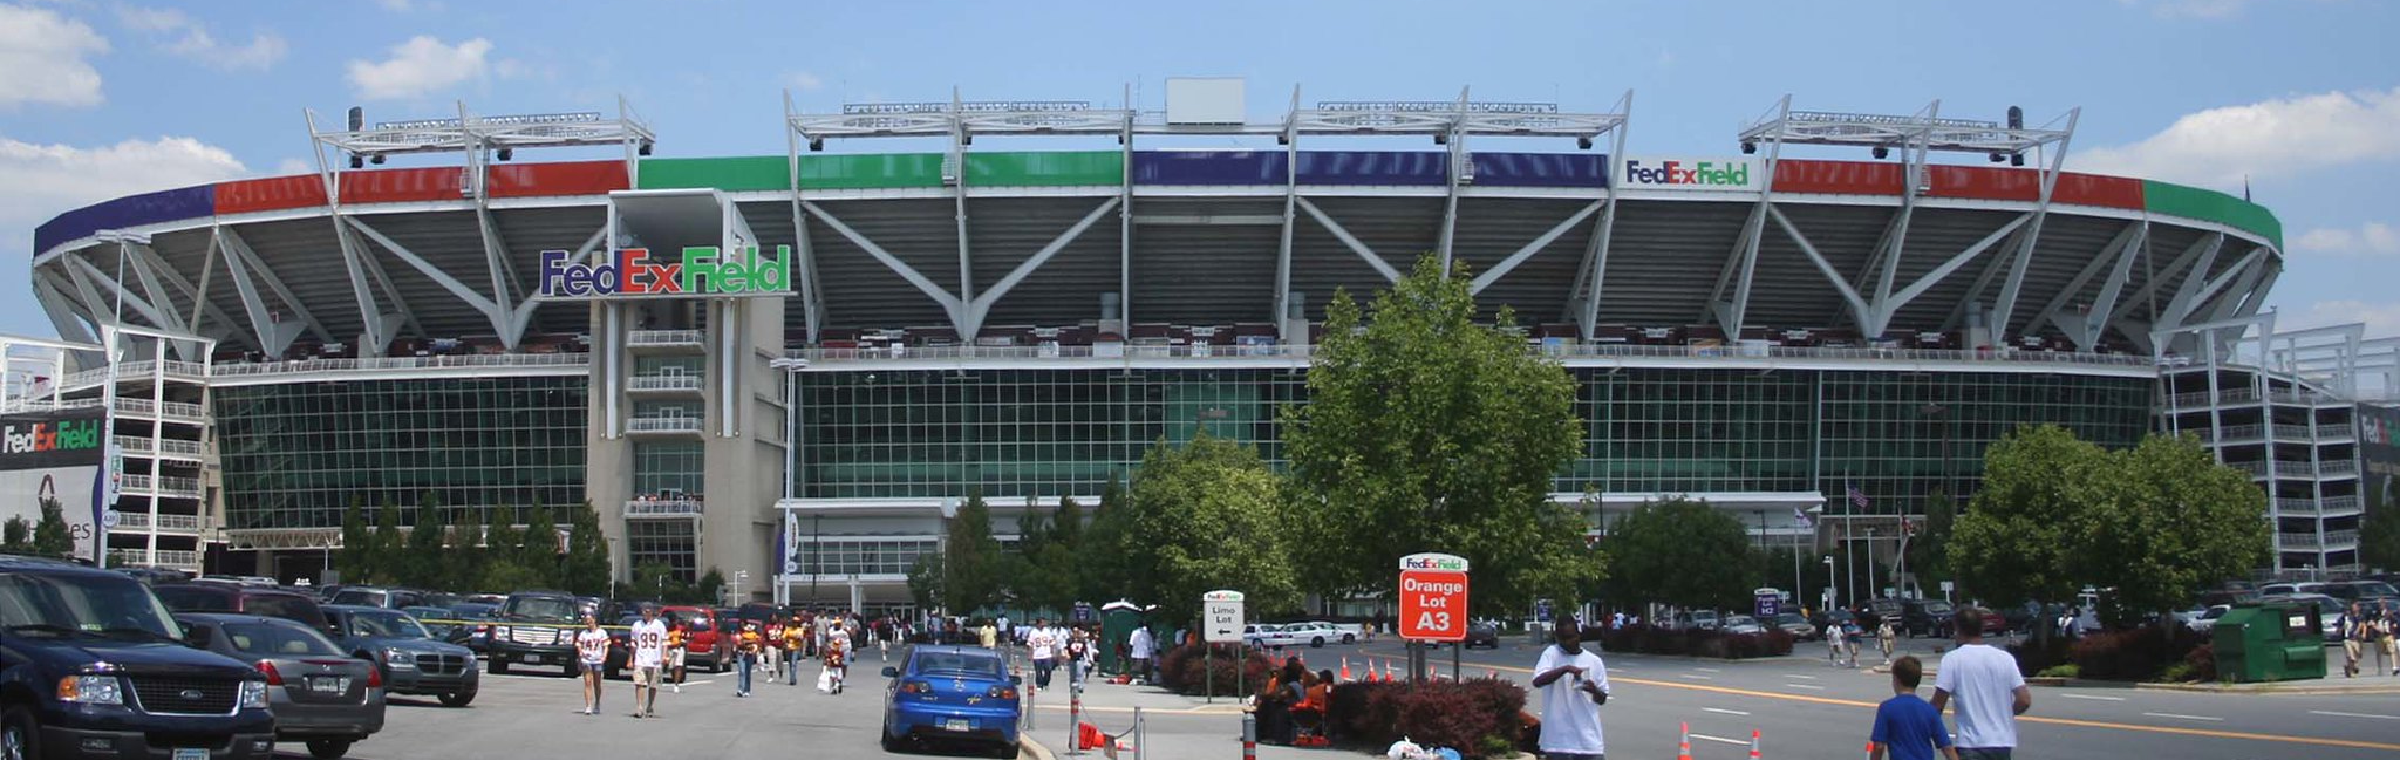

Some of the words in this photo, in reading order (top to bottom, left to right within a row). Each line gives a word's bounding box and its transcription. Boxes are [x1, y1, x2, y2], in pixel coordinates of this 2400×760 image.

[1627, 160, 1748, 186] FedExField
[540, 244, 790, 296] FedExField
[4, 419, 98, 454] FedExField
[1404, 578, 1464, 596] Orange
[1212, 605, 1236, 614] Limo
[1419, 595, 1447, 608] Lot
[1416, 611, 1451, 632] A3
[640, 632, 657, 649] 99
